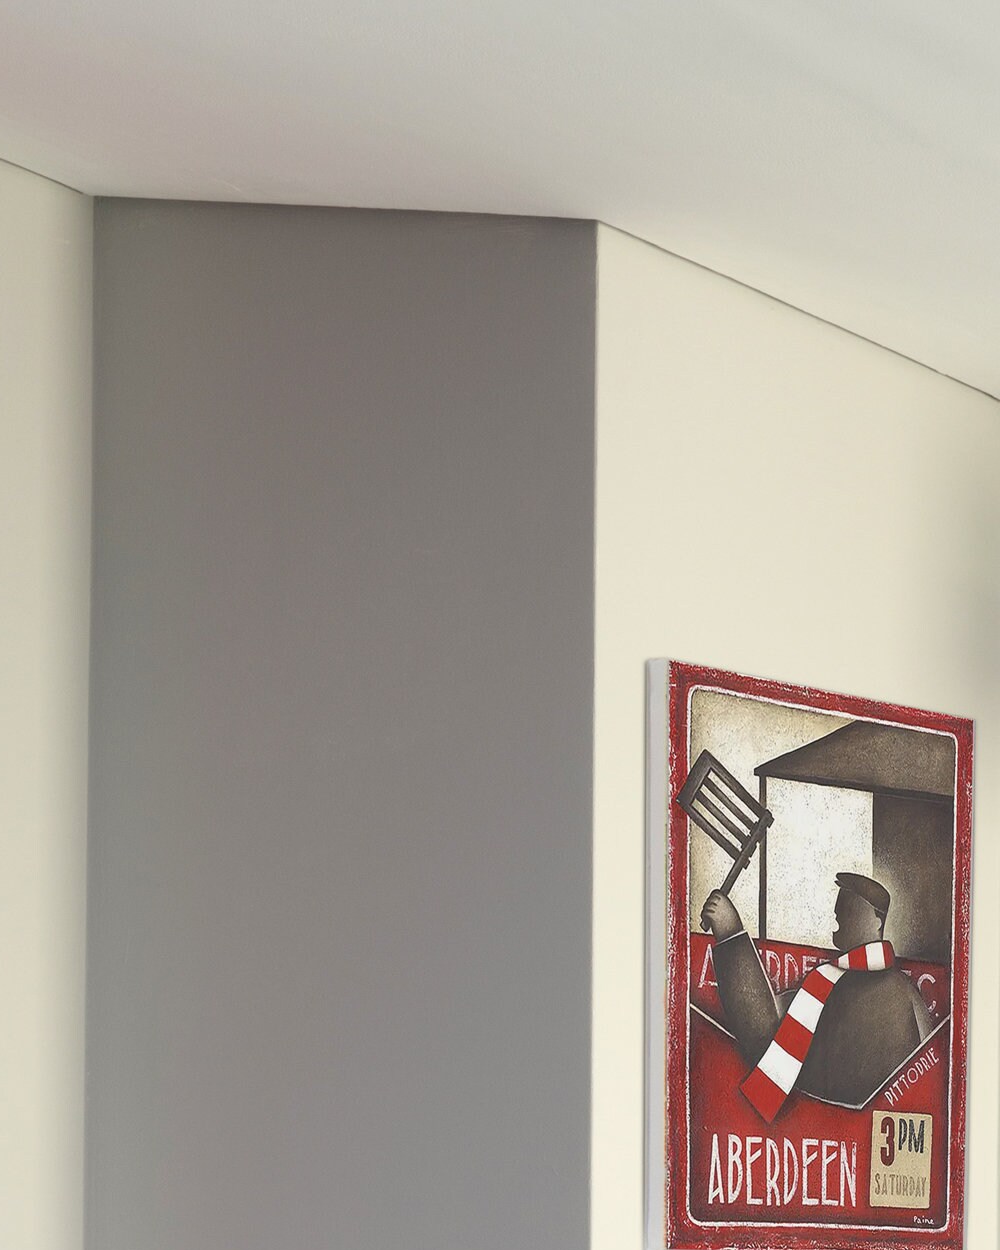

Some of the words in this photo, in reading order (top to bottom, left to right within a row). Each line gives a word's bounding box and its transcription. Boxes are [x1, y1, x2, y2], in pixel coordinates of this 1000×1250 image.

[884, 1047, 940, 1107] PITTODRIE
[707, 1132, 857, 1208] ABERDEEN
[874, 1173, 927, 1198] SATURDAY
[913, 1215, 935, 1225] Paine
